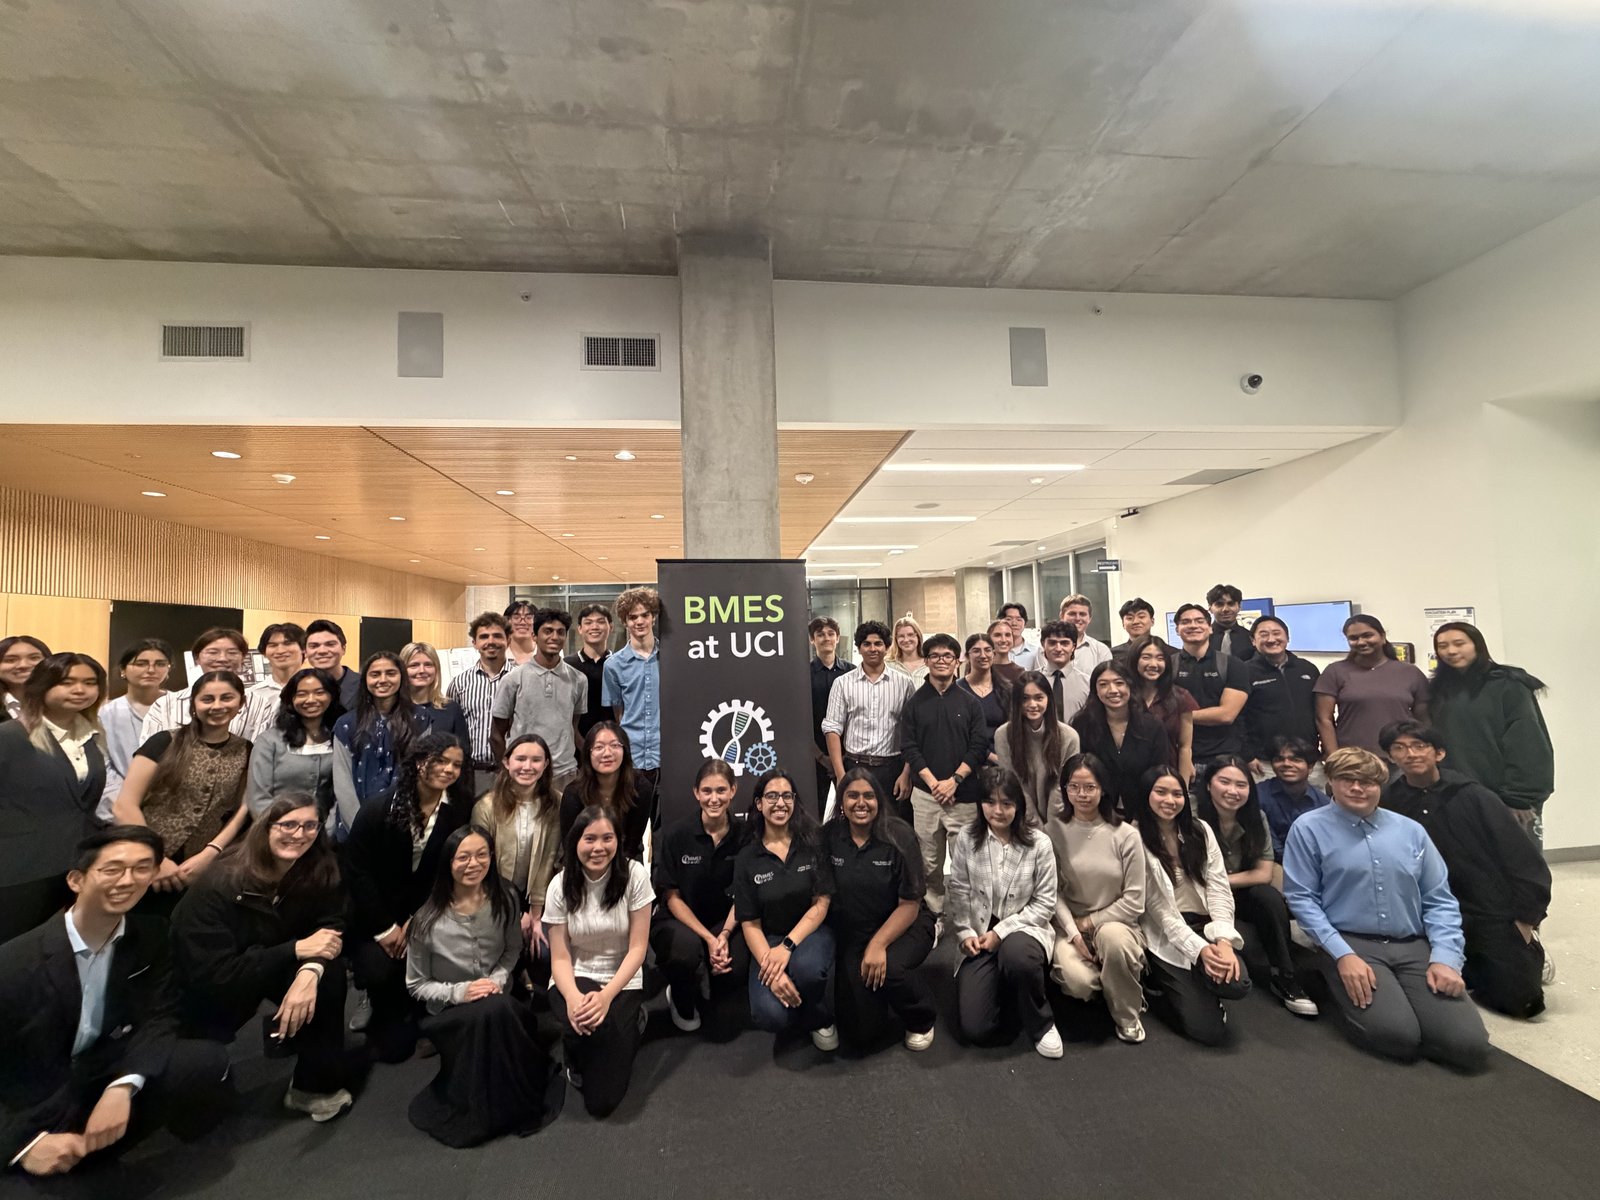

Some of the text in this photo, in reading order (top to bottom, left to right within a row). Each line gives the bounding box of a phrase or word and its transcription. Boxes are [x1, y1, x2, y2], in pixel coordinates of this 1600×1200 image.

[684, 594, 784, 624] BMES
[688, 631, 784, 659] at UCI
